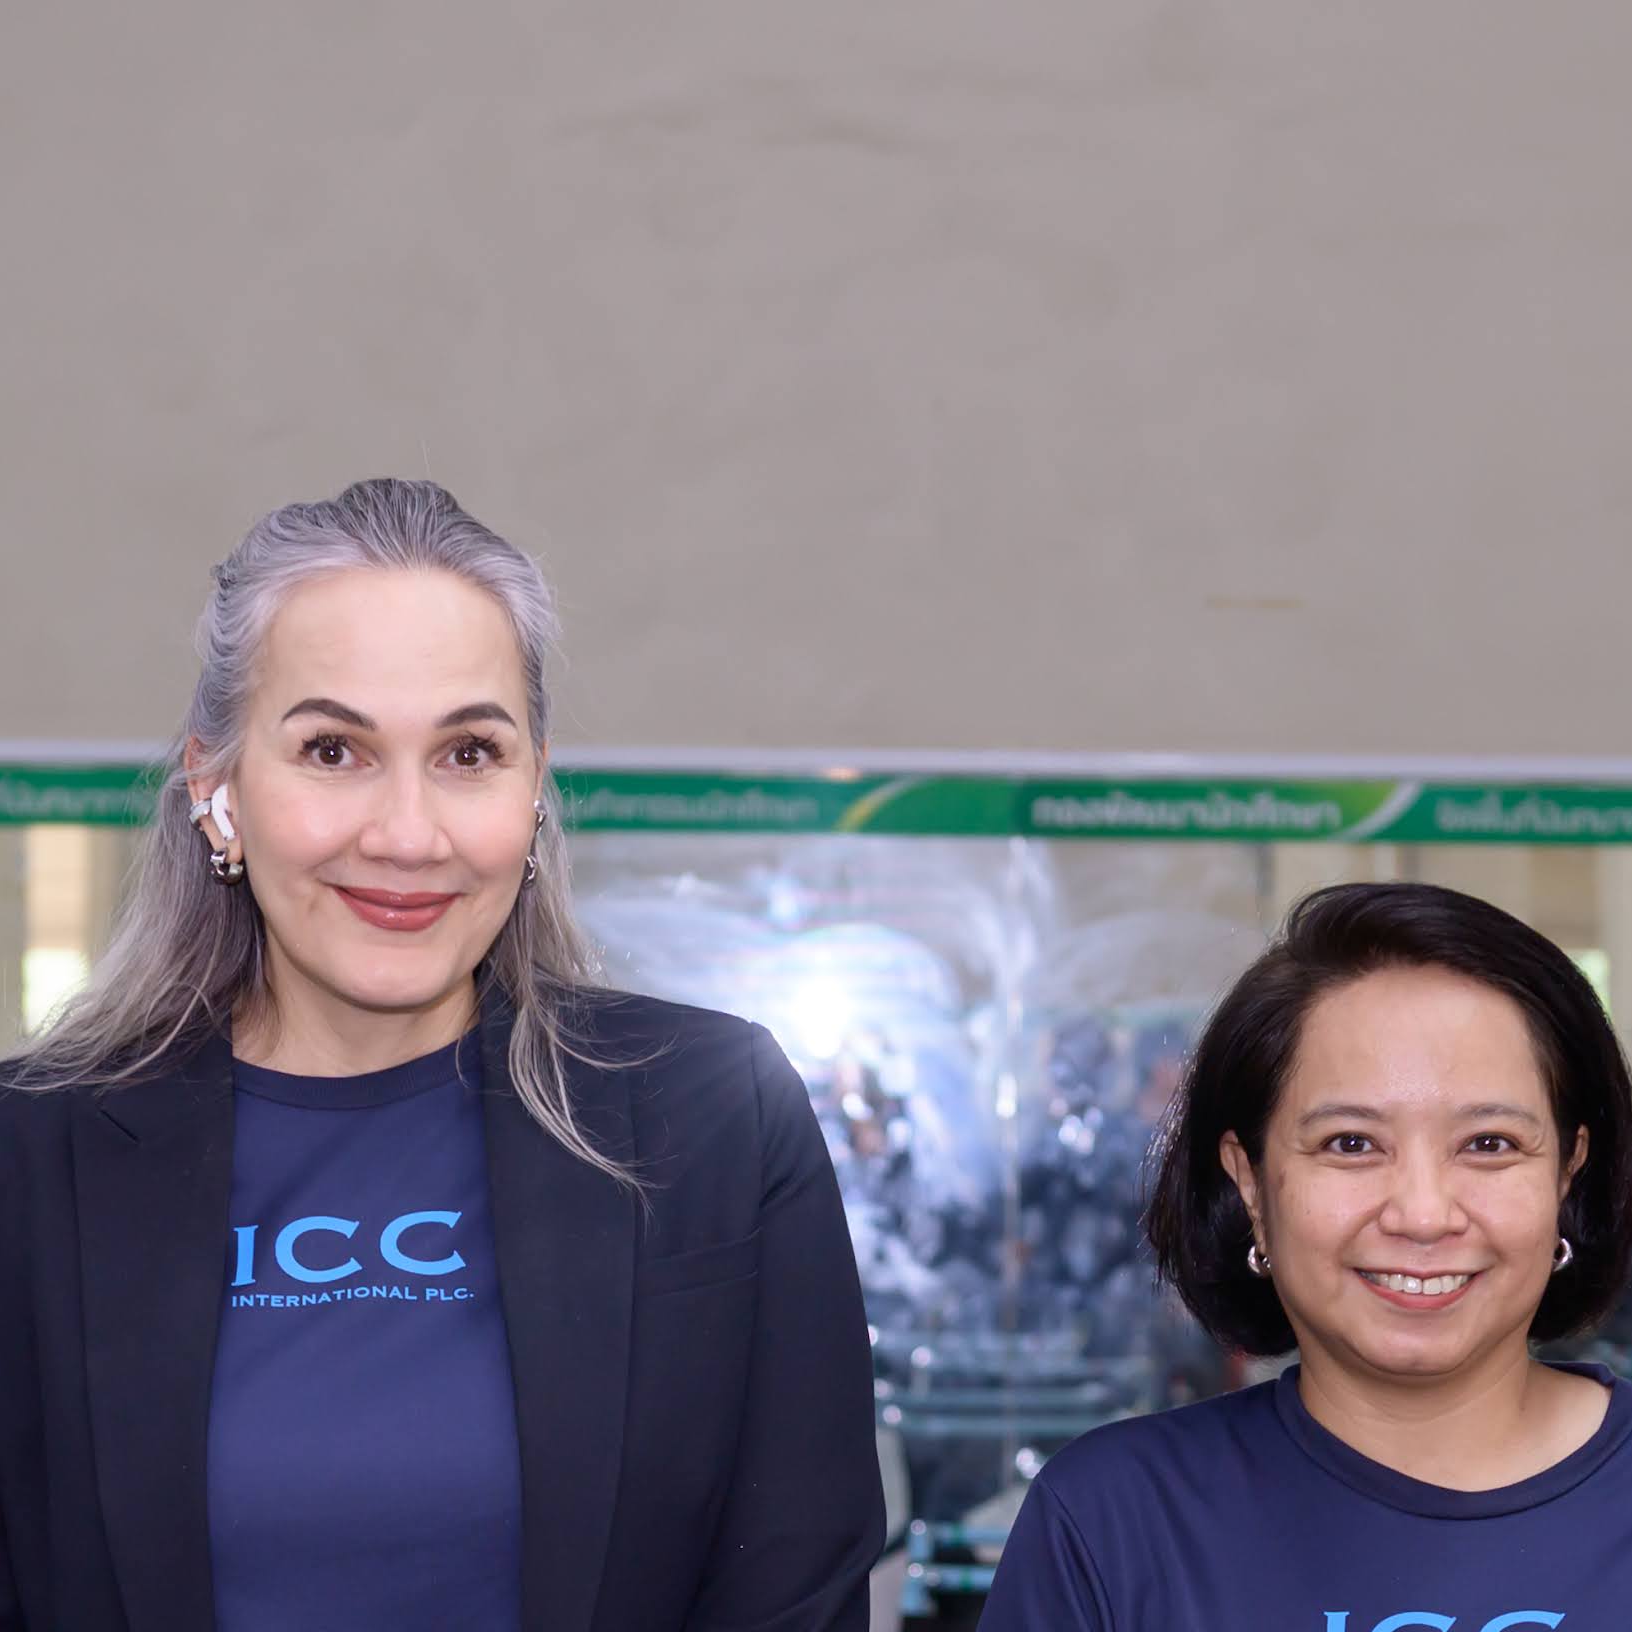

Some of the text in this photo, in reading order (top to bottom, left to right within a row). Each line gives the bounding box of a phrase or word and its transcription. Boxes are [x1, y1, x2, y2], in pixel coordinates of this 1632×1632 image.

[231, 1211, 466, 1286] ICC
[232, 1286, 474, 1307] INTERNATIONAL PLC.
